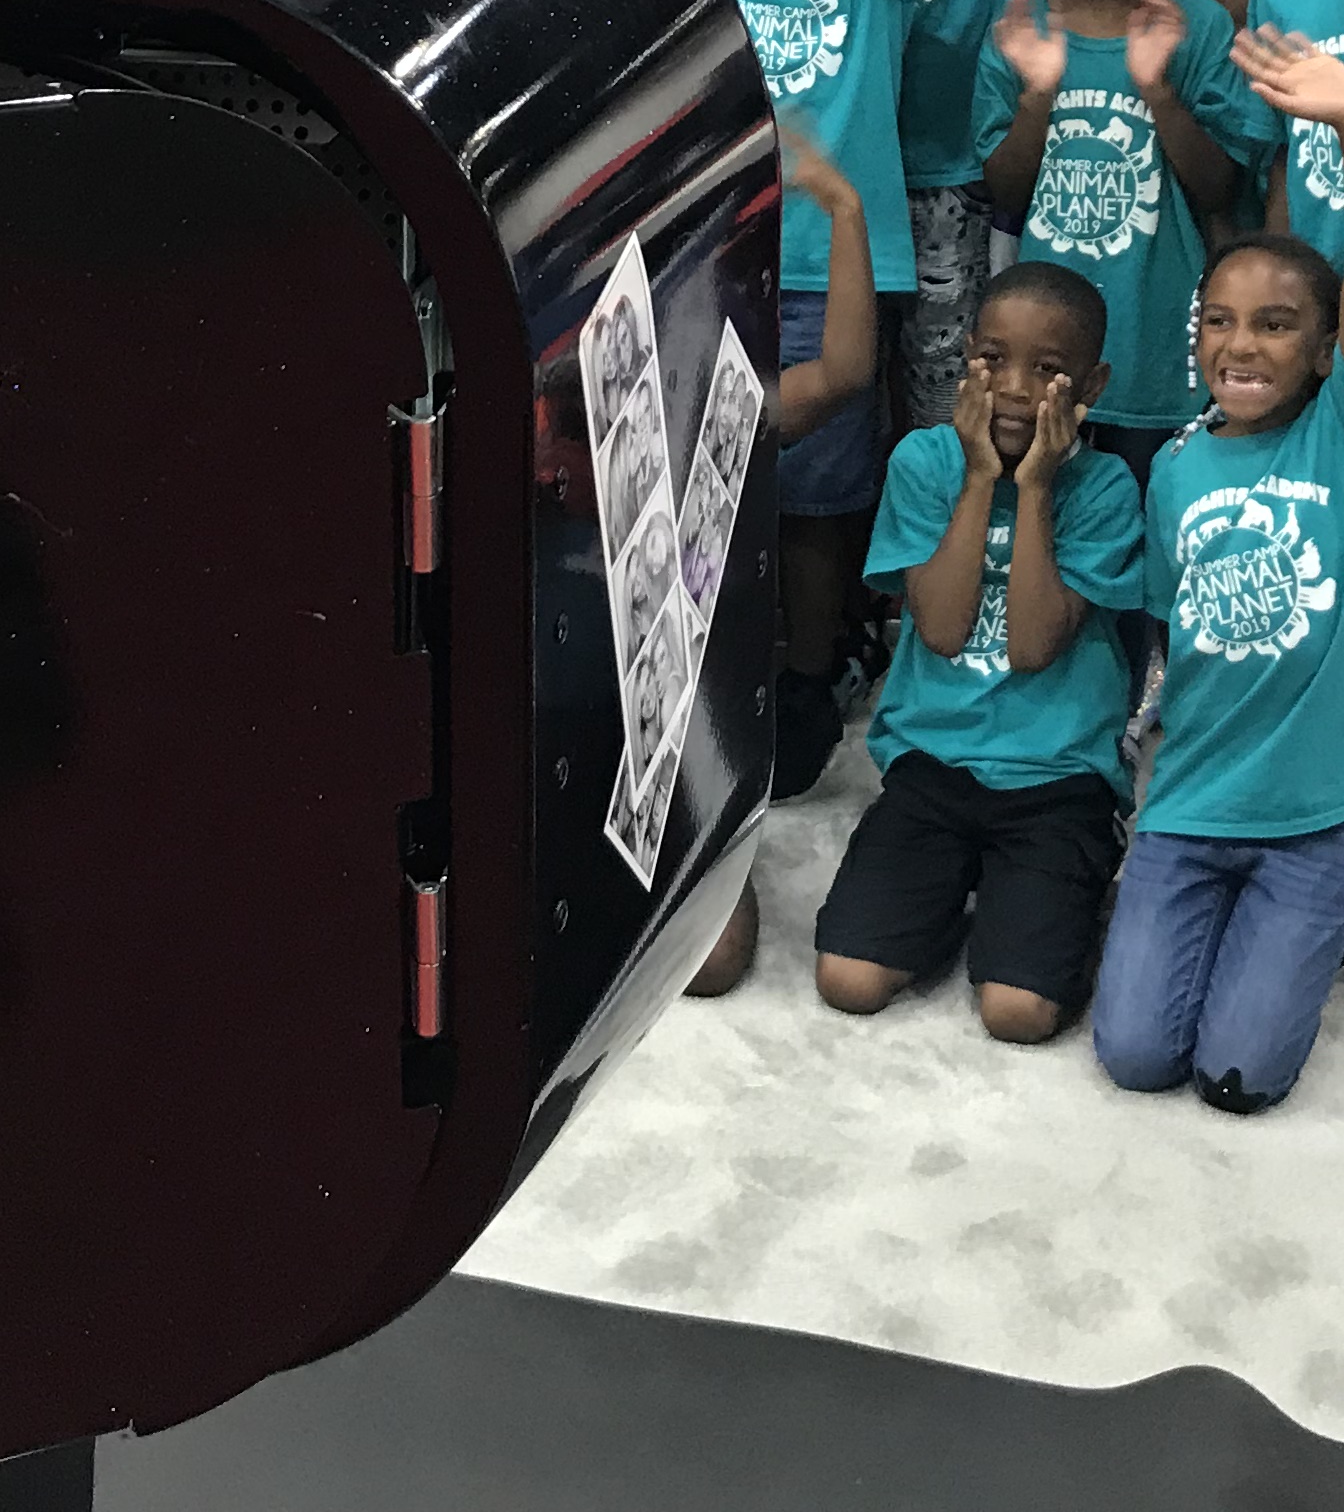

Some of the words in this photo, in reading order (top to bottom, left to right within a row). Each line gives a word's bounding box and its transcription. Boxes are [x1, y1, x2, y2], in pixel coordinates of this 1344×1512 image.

[782, 6, 819, 20] CAMP
[754, 34, 819, 60] ANET
[758, 54, 787, 71] 019
[1043, 157, 1092, 172] SUMMER
[1094, 160, 1131, 173] CAMP
[1038, 169, 1132, 197] ANIMAL
[1041, 192, 1132, 221] PLANET
[1063, 218, 1102, 235] 2019
[1249, 473, 1331, 507] CADEMY
[1192, 552, 1241, 578] SUMMER
[1242, 543, 1281, 565] CAMP
[1196, 557, 1292, 603] ANIMAL
[1202, 581, 1295, 630] PLANET
[1230, 614, 1271, 639] 2019
